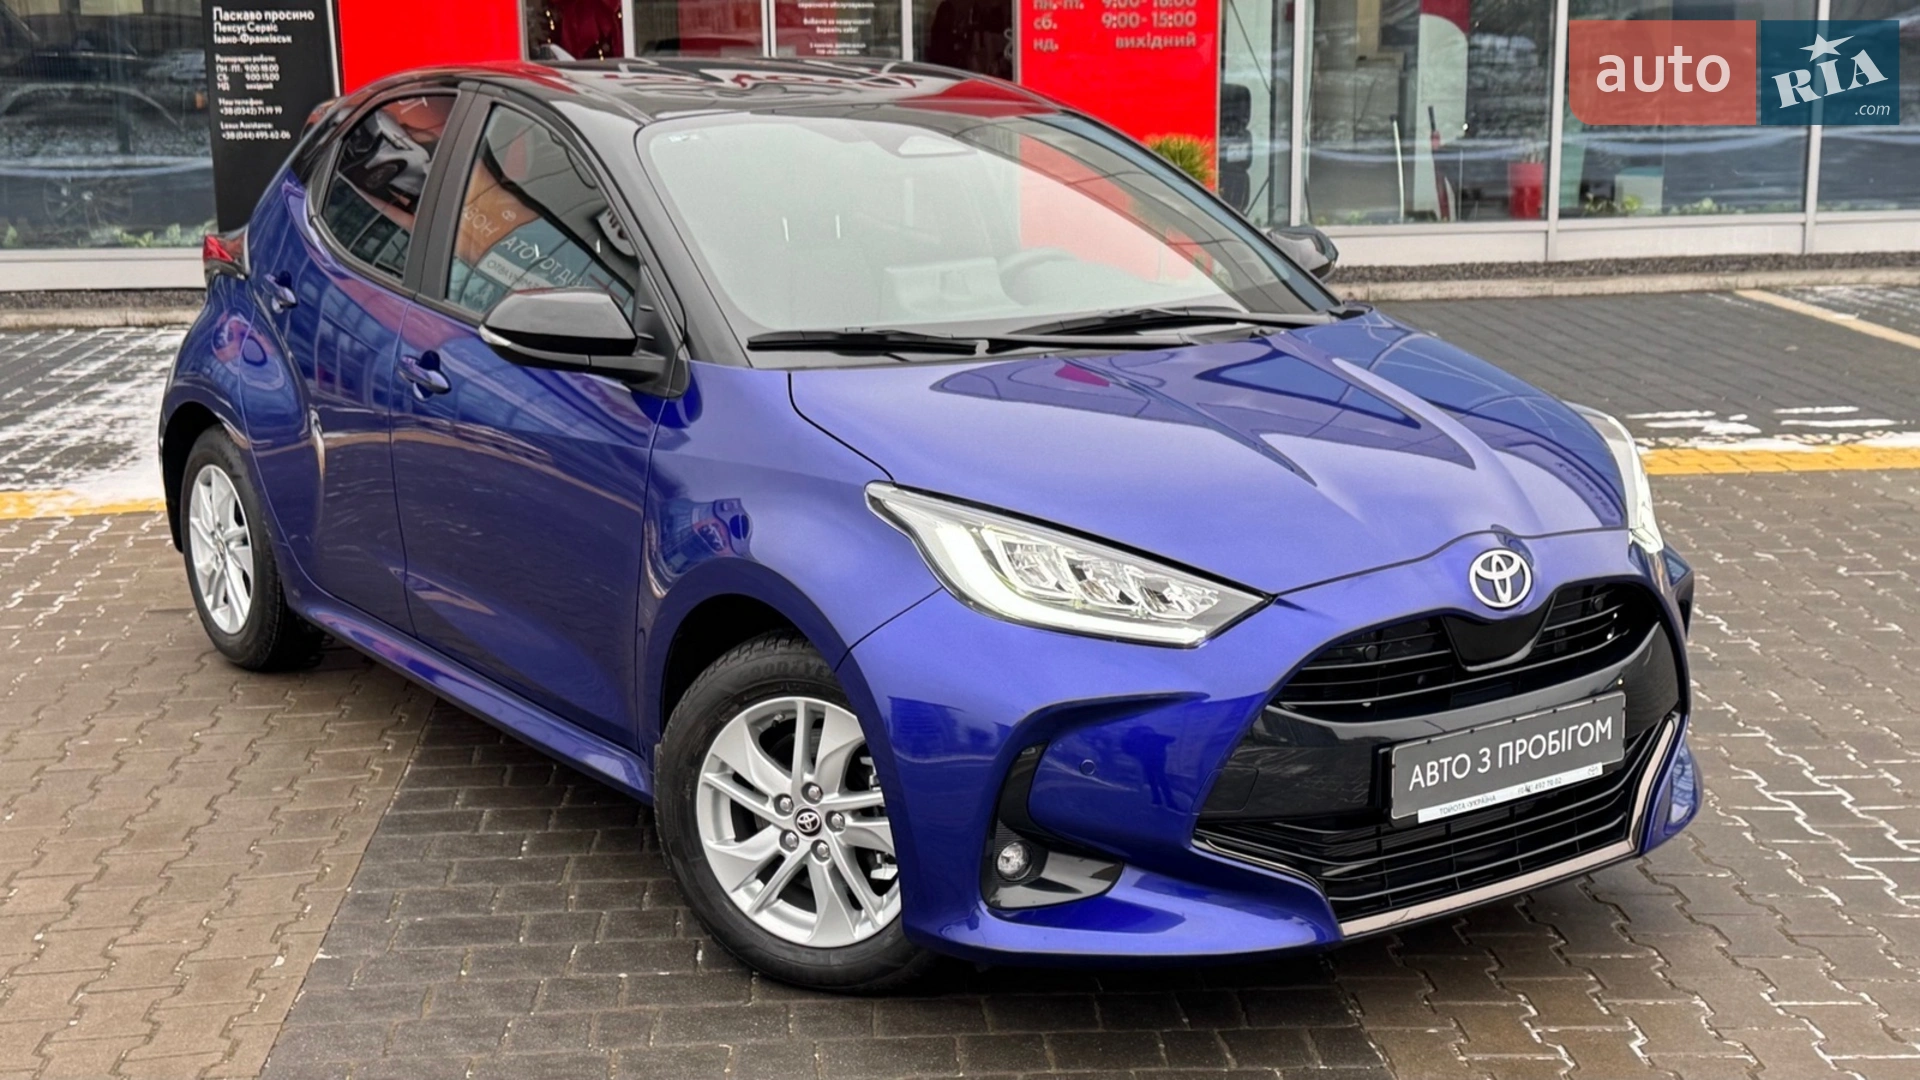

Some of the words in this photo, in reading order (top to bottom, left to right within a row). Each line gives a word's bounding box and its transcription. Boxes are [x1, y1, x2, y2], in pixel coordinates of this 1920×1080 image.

[264, 10, 315, 23] просимо
[1033, 13, 1058, 30] сб.
[214, 33, 292, 45] Івано-Франківськ
[1033, 38, 1059, 52] нд.
[1115, 31, 1197, 51] вихідний
[1409, 753, 1471, 792] АВТО
[1498, 716, 1613, 769] ПРОБІГОМ
